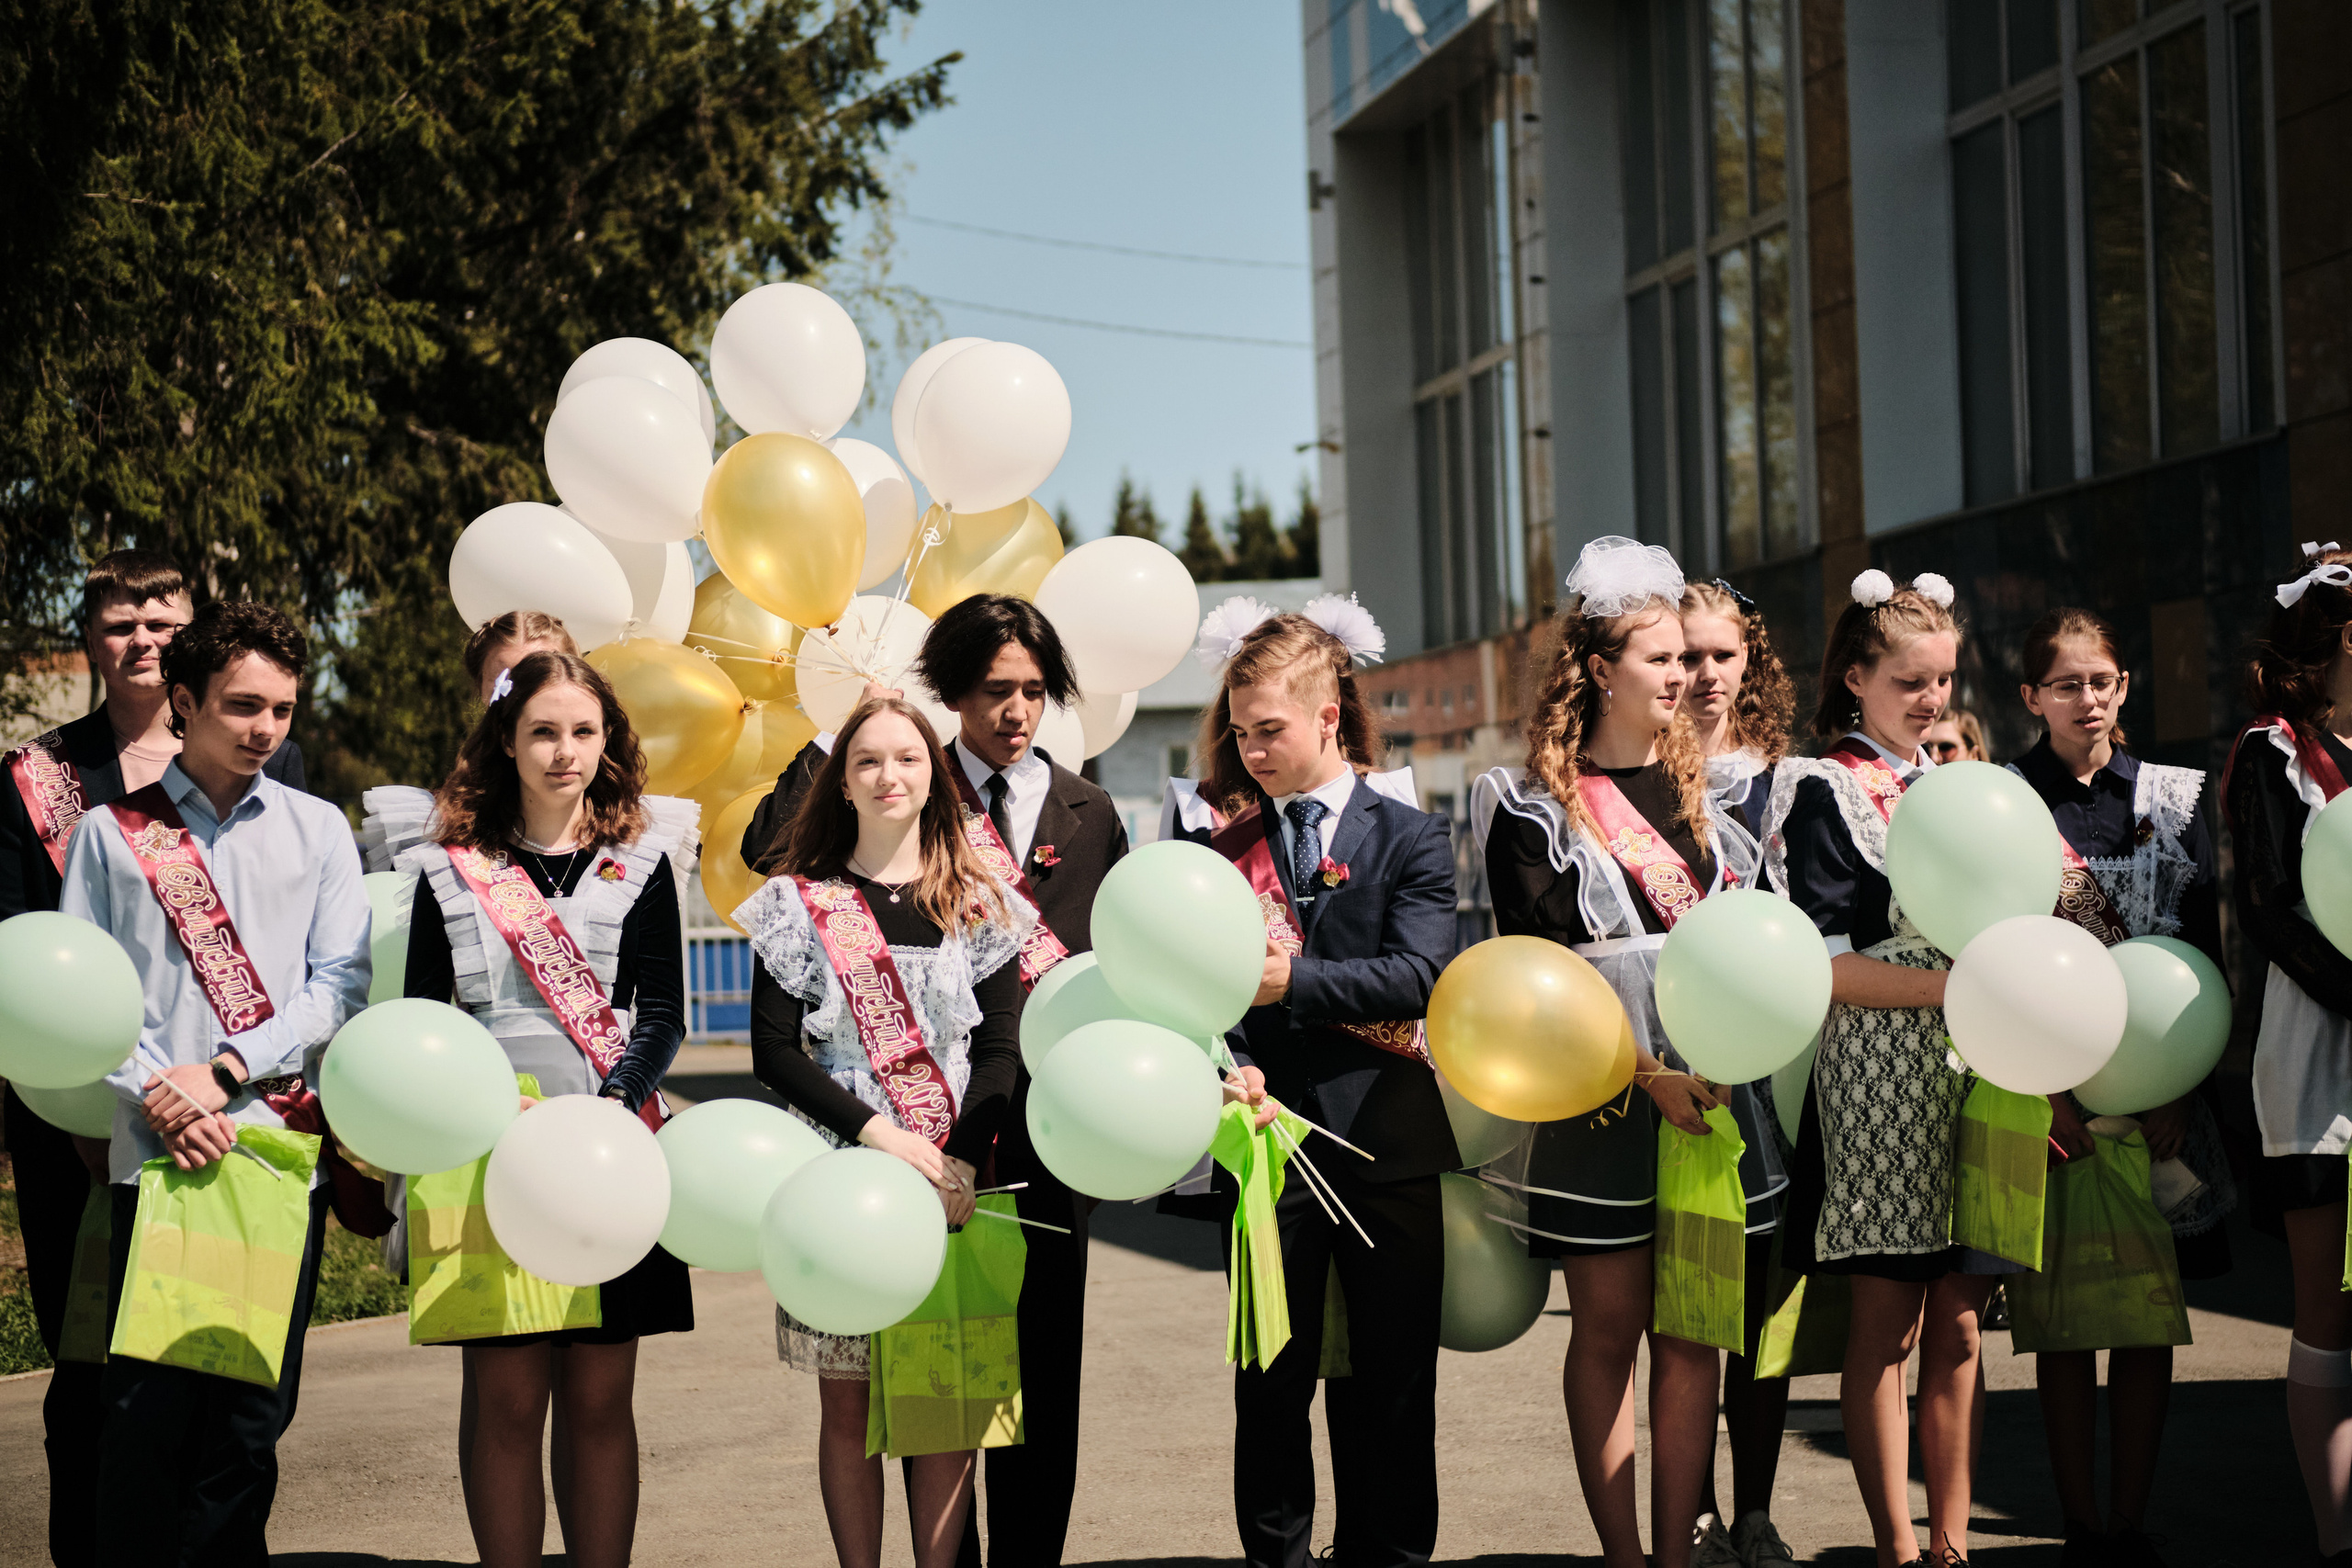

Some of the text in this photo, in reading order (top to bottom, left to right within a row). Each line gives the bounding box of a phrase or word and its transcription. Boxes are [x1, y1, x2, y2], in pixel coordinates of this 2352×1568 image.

[156, 863, 267, 1033] Выпускник
[489, 880, 610, 1040] Выпускник
[826, 910, 954, 1143] Выпускник 2023
